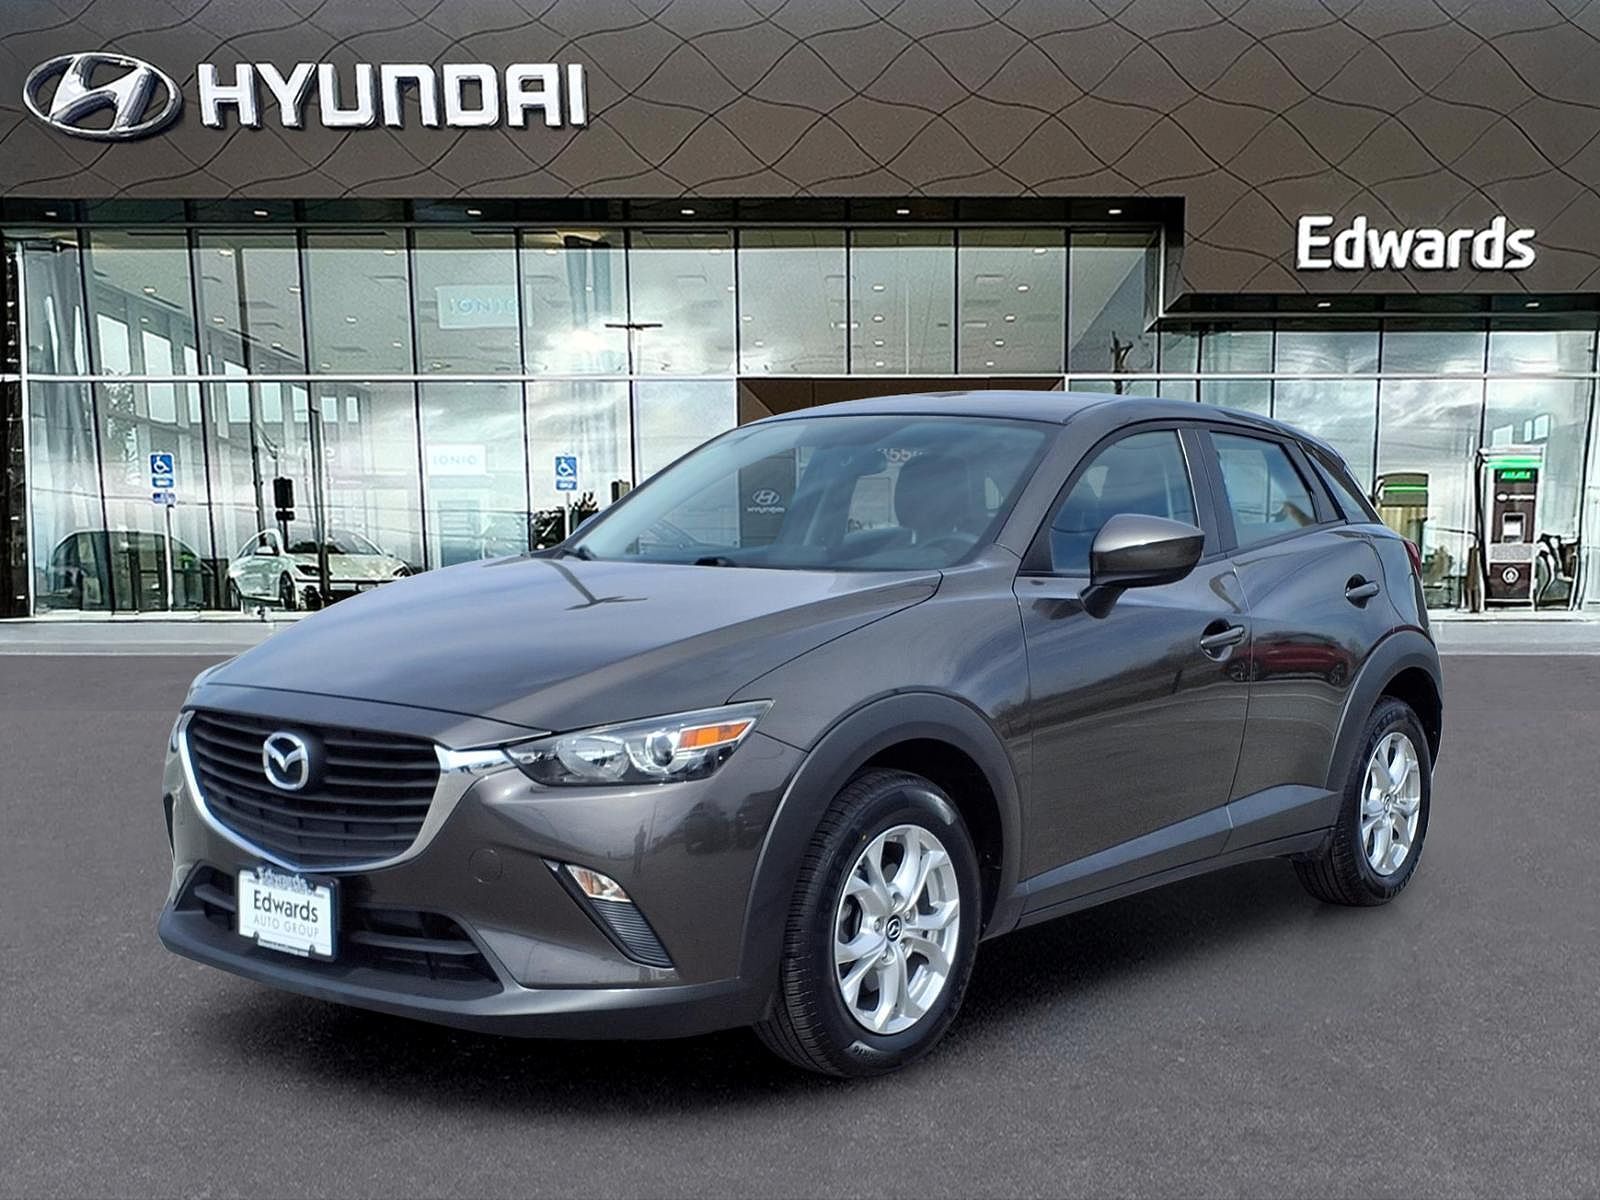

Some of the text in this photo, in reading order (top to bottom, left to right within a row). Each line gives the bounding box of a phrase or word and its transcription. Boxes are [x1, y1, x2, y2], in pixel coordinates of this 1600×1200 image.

[197, 62, 588, 128] HYUNDAI
[1296, 214, 1537, 271] Edwards
[253, 889, 319, 924] Edwards
[254, 914, 320, 937] AUTO GROUP
